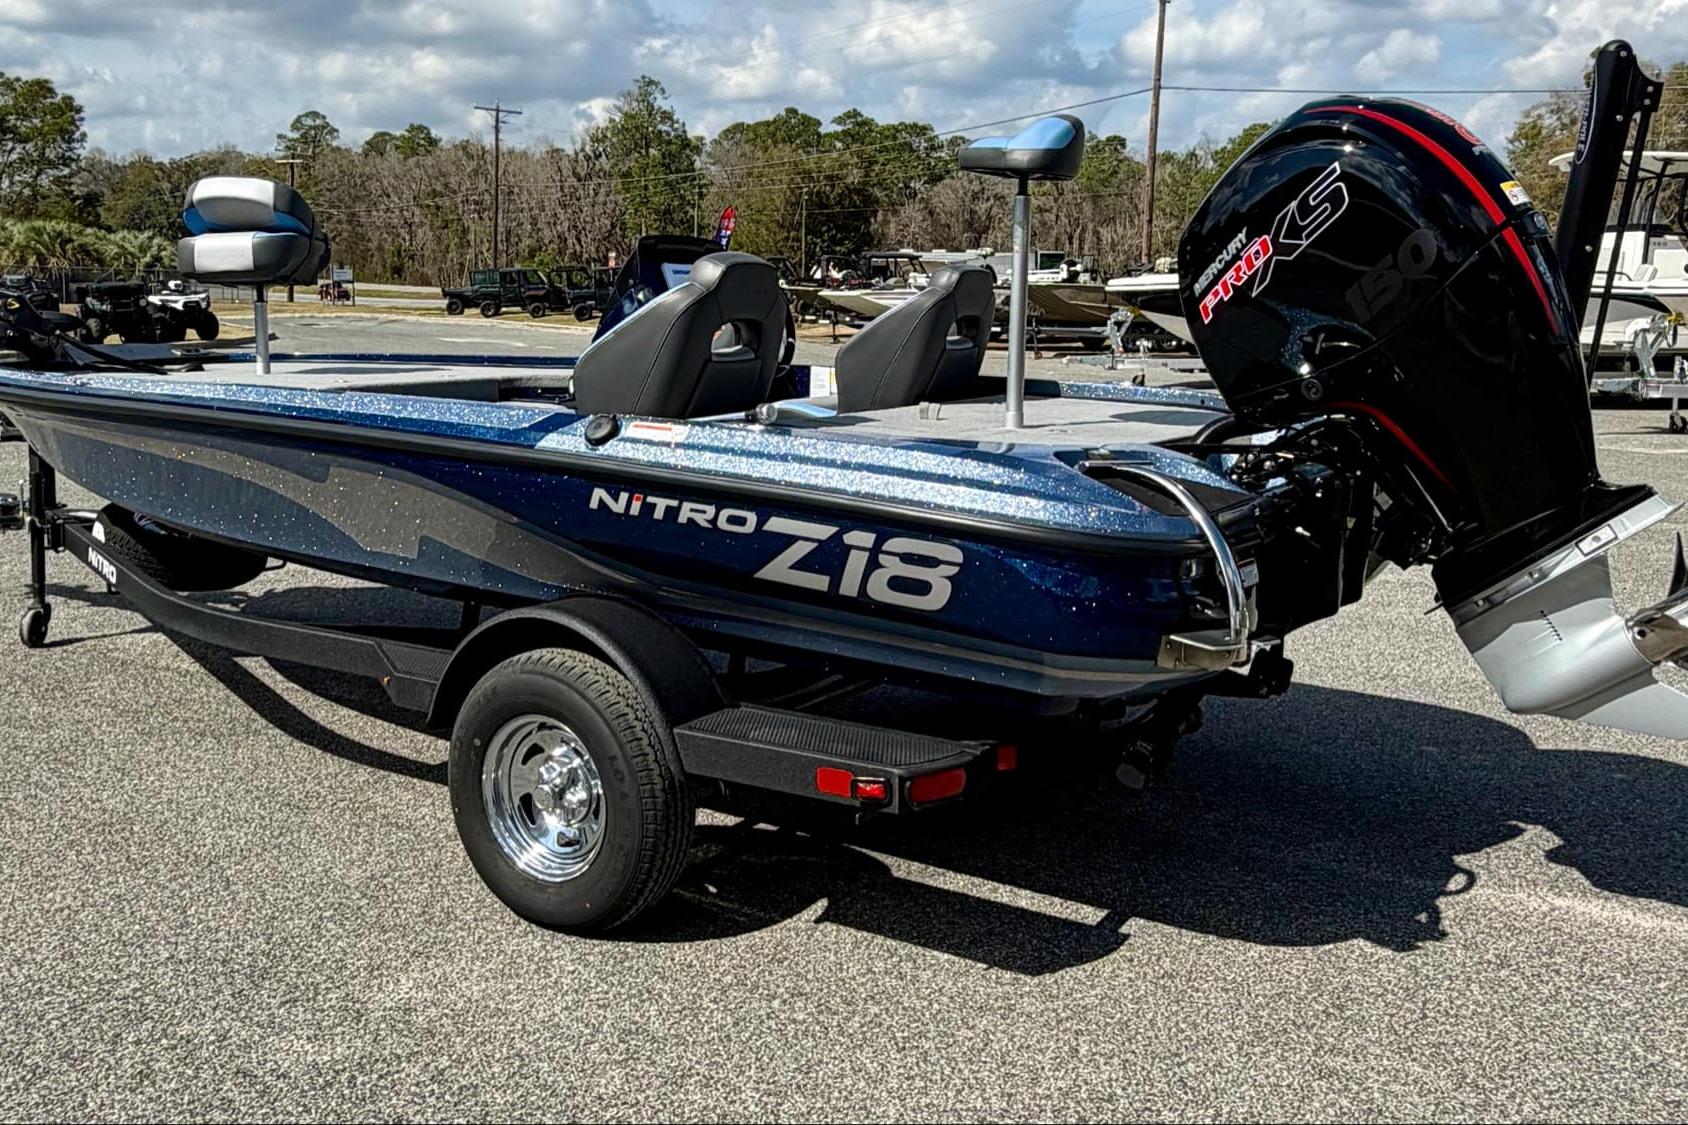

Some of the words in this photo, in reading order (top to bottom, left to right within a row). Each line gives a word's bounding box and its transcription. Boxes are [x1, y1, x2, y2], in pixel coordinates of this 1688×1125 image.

[1193, 226, 1247, 298] MERCURY
[1199, 234, 1273, 325] PRO
[1345, 228, 1438, 320] 150
[589, 487, 758, 534] NITRO
[88, 546, 117, 584] NITRO
[753, 516, 964, 611] Z18
